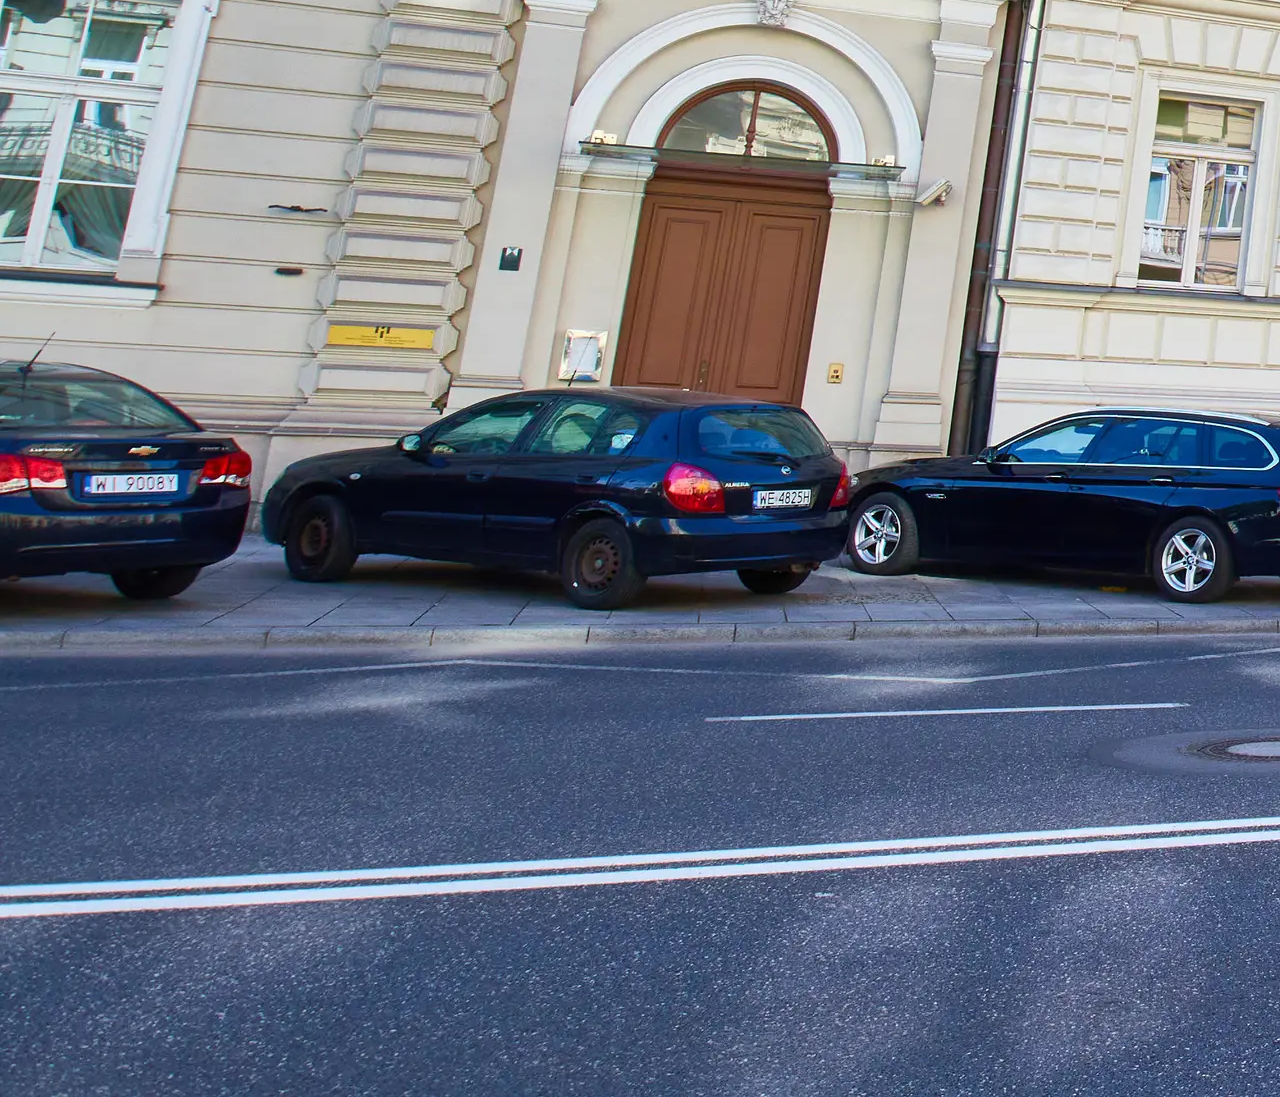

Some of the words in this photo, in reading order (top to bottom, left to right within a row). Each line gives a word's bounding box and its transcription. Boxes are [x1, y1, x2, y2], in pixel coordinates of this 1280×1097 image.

[96, 476, 117, 492] WI
[126, 475, 175, 490] 9008Y
[760, 492, 775, 505] WE
[779, 490, 810, 504] 4825H
